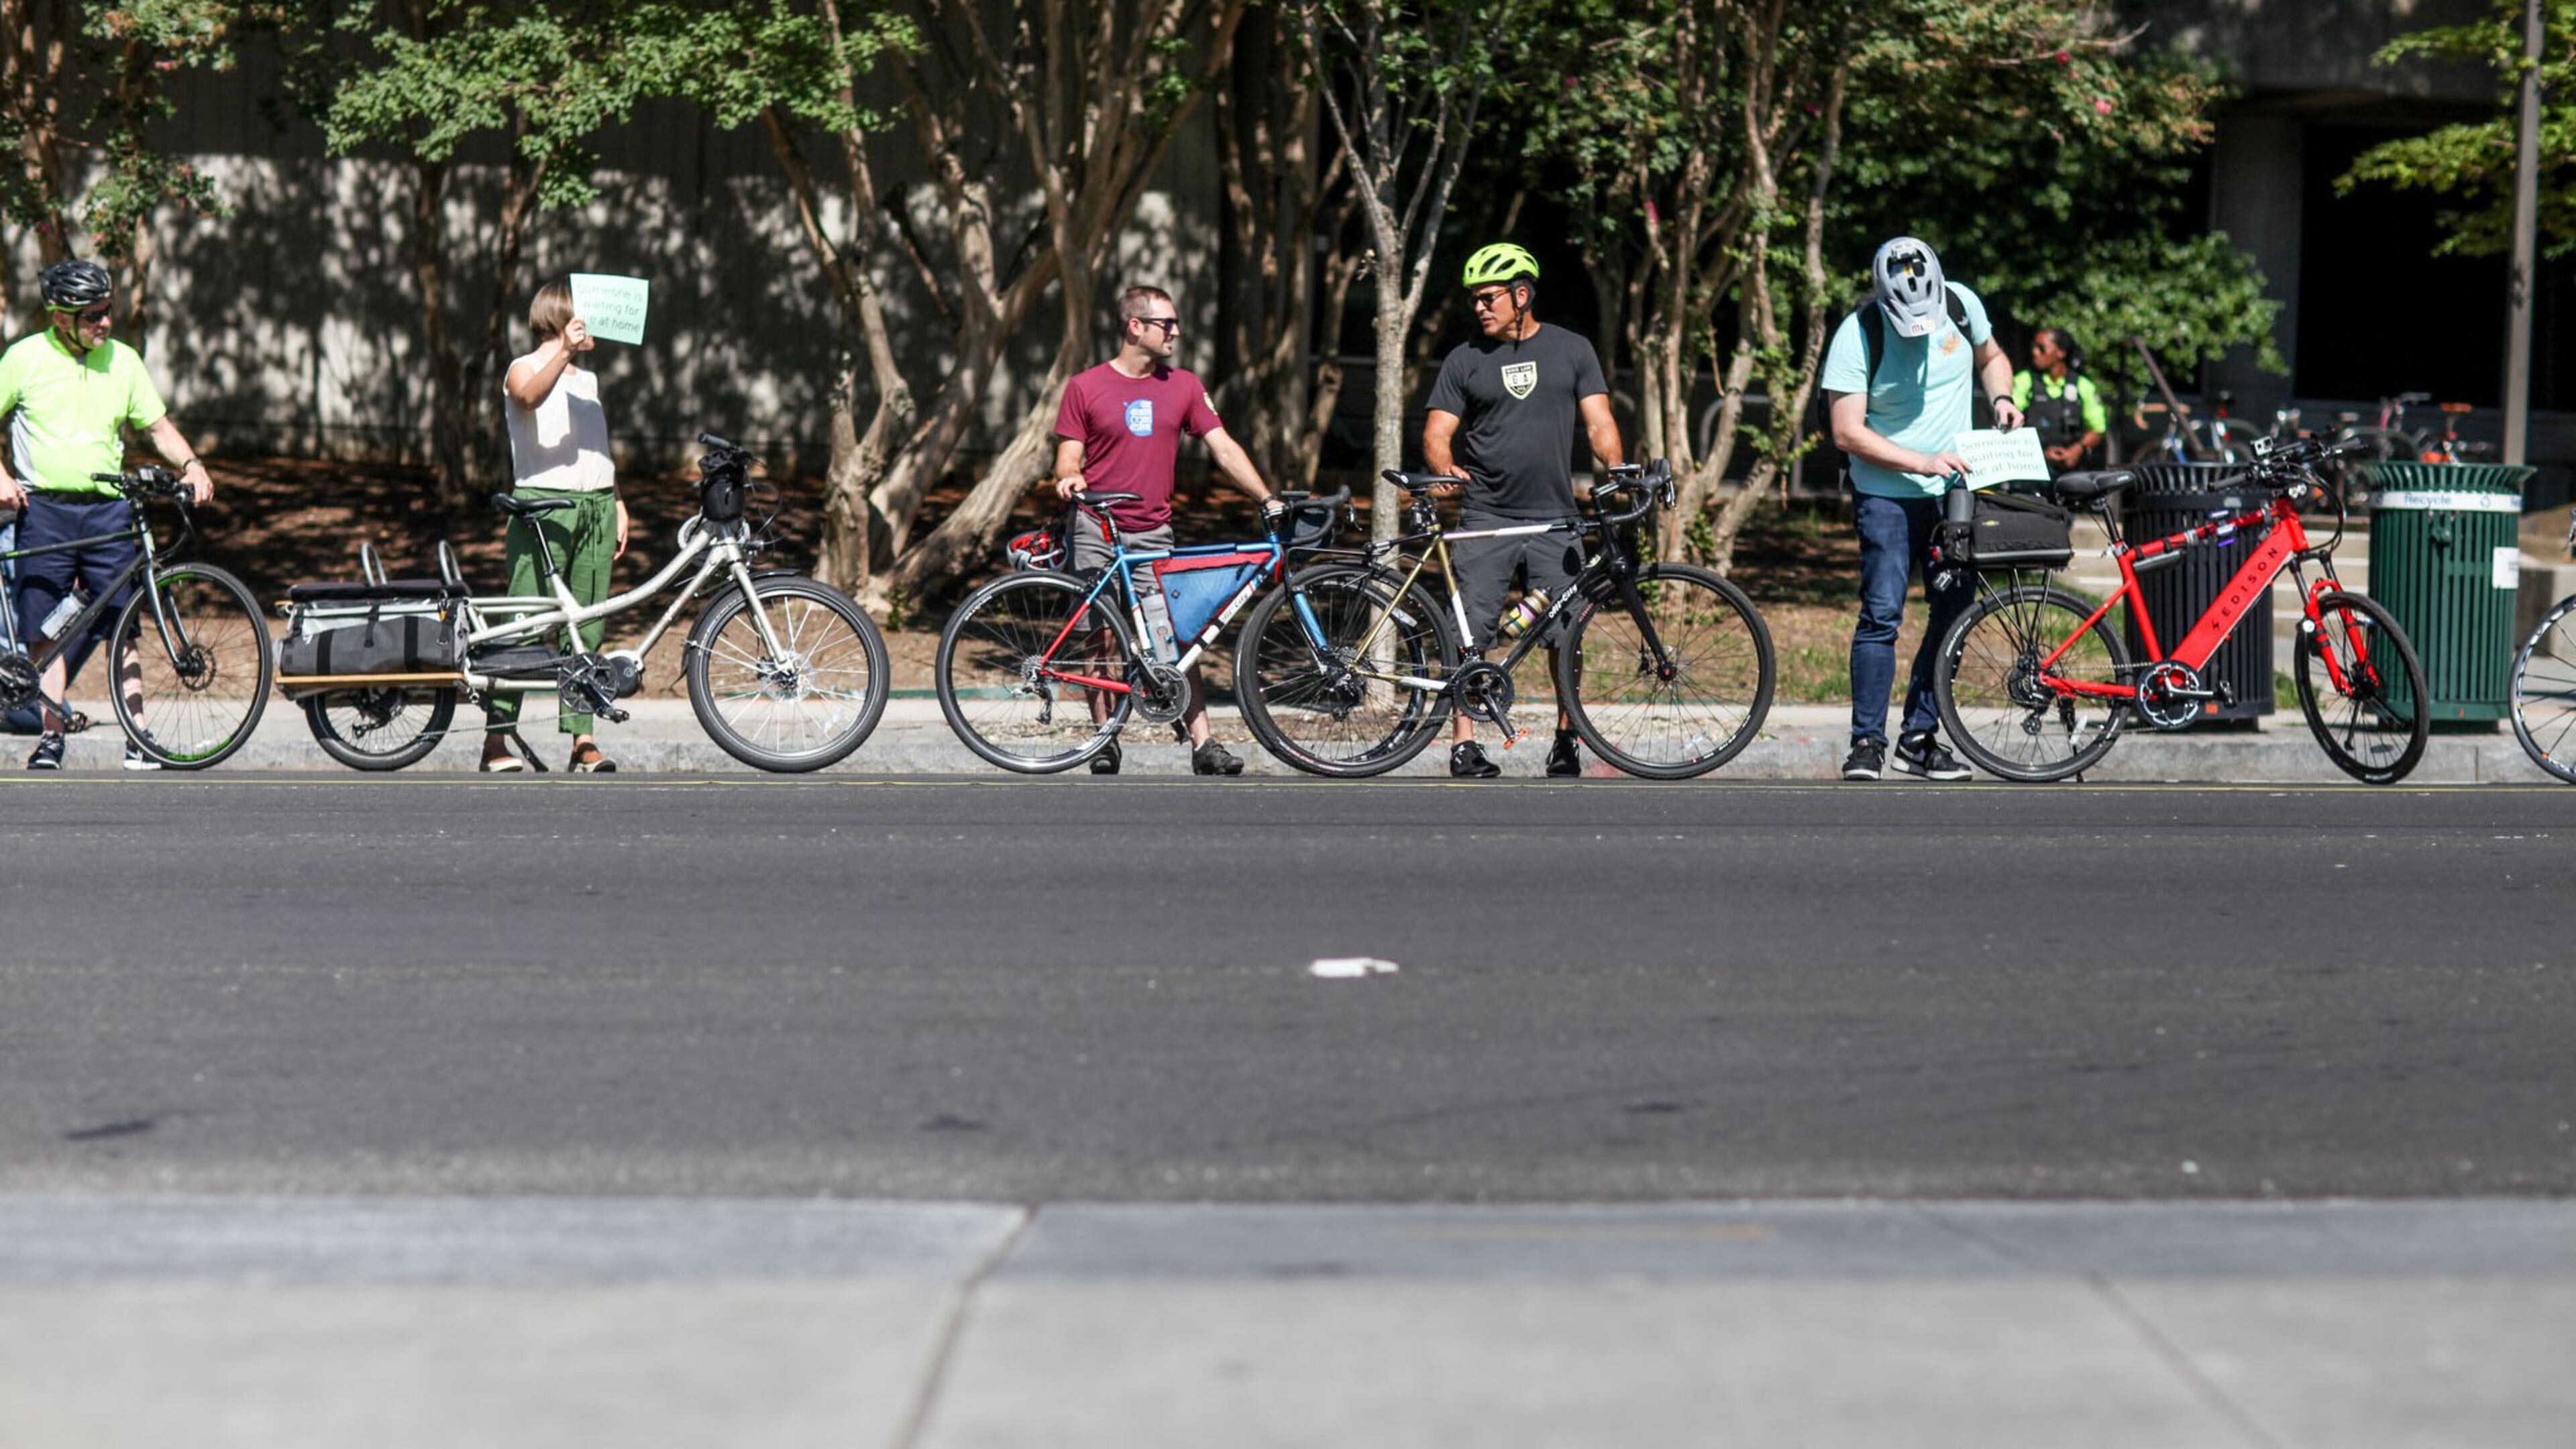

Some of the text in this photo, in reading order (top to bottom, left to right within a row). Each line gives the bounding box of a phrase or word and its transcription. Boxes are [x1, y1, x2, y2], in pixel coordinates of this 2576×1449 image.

[634, 292, 642, 302] is
[625, 304, 639, 317] for
[598, 316, 609, 326] at
[612, 319, 641, 333] home
[1962, 438, 2020, 451] Someone
[1968, 449, 2033, 464] waiting for
[1991, 463, 2003, 473] at
[2008, 462, 2043, 471] home
[2404, 492, 2452, 508] Recycle
[2221, 548, 2278, 616] EDISON
[1548, 584, 1578, 619] All-City
